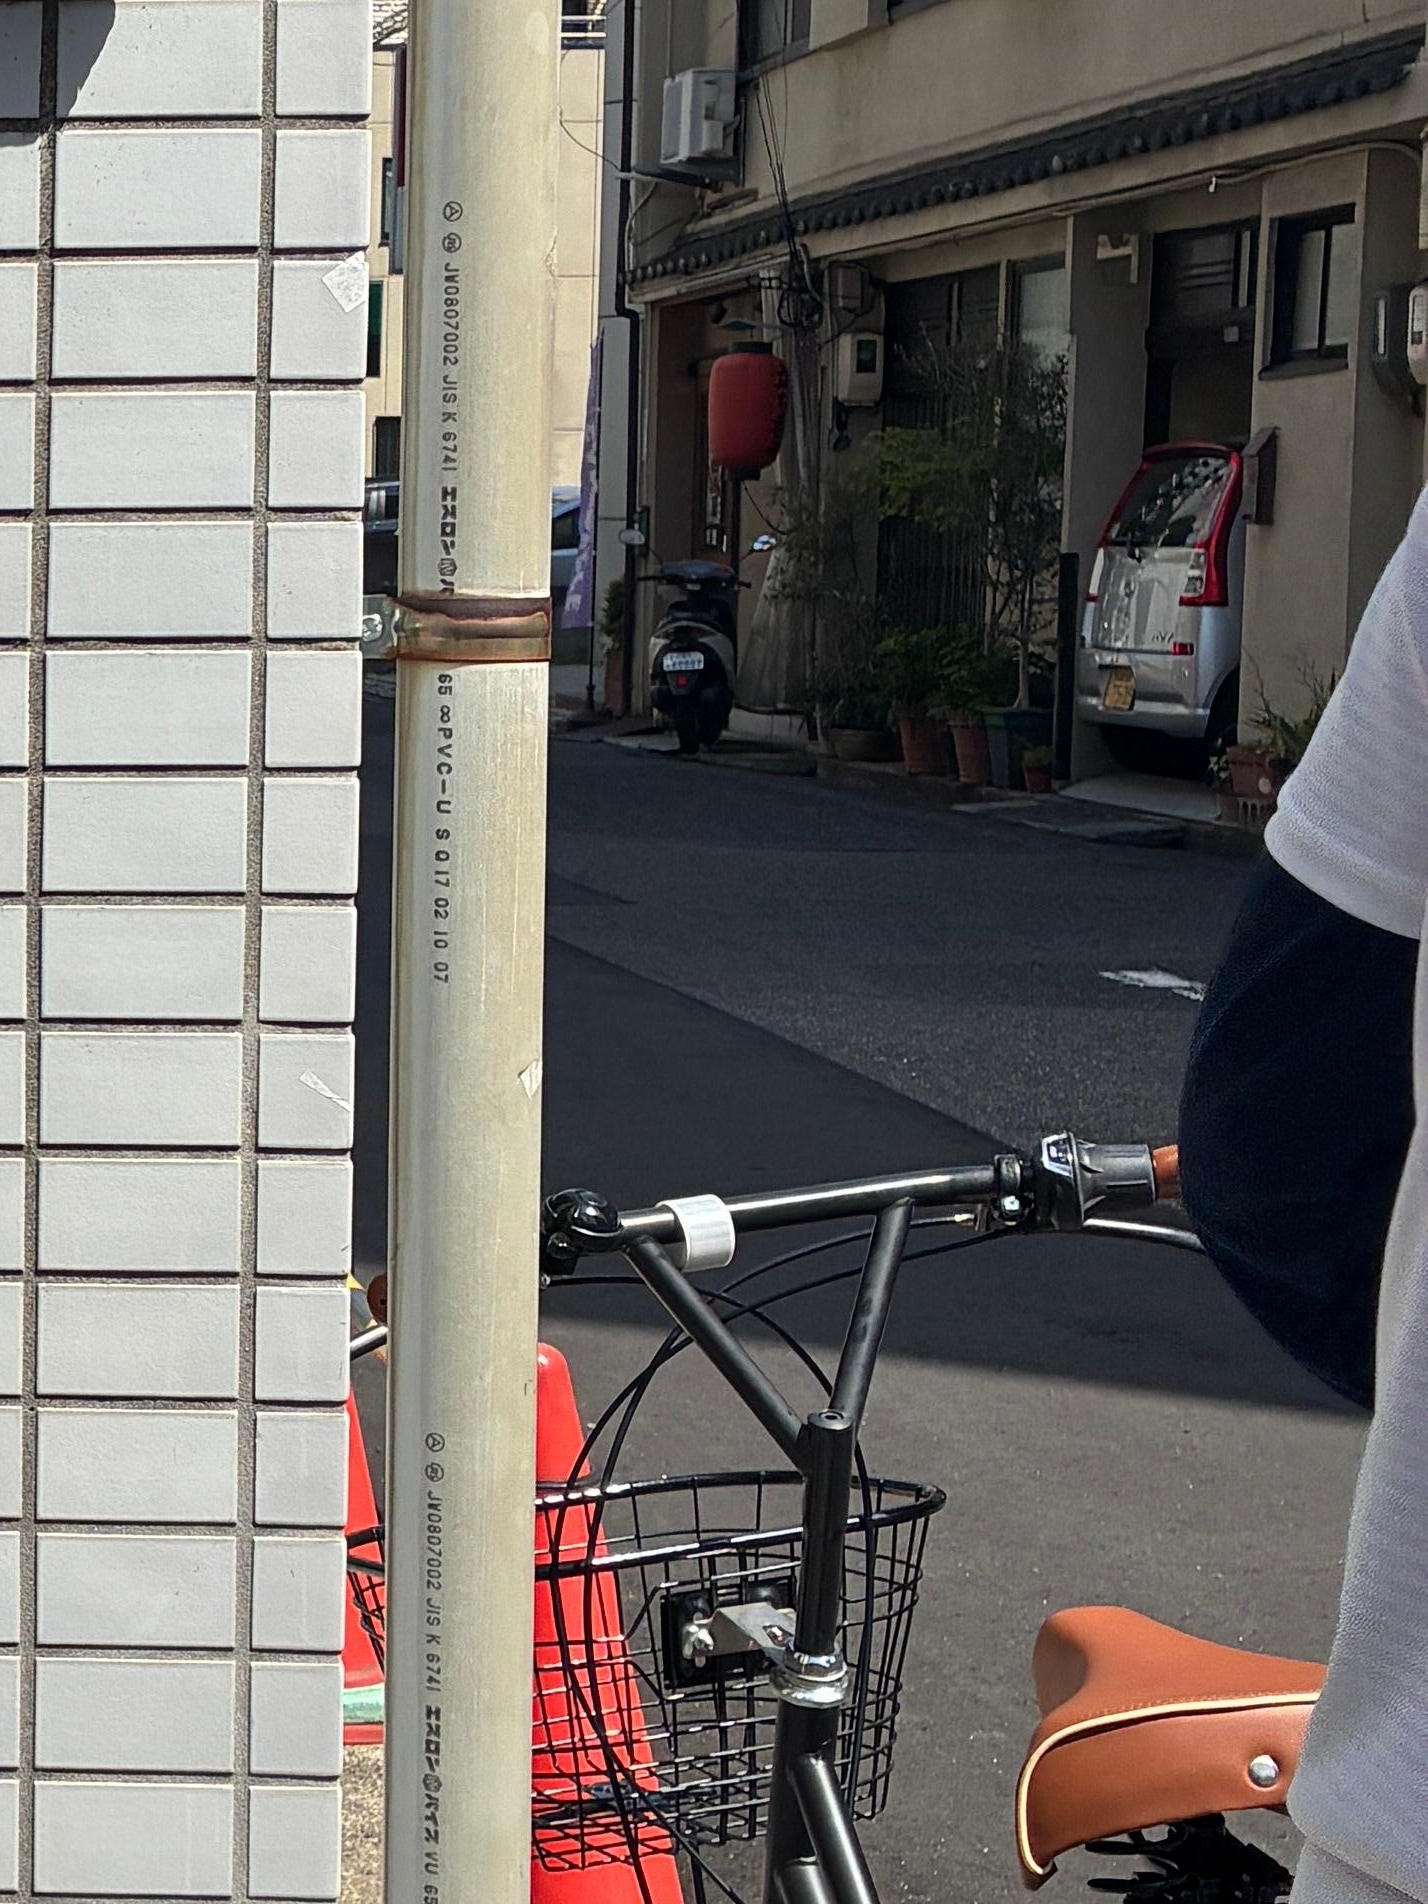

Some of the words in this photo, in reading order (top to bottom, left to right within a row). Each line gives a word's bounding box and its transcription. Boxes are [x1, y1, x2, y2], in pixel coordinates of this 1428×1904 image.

[442, 374, 458, 403] JIS
[438, 674, 453, 696] 65
[434, 898, 449, 920] 02
[434, 962, 449, 983] 07
[426, 1597, 441, 1626] JIS
[424, 1852, 439, 1875] VU
